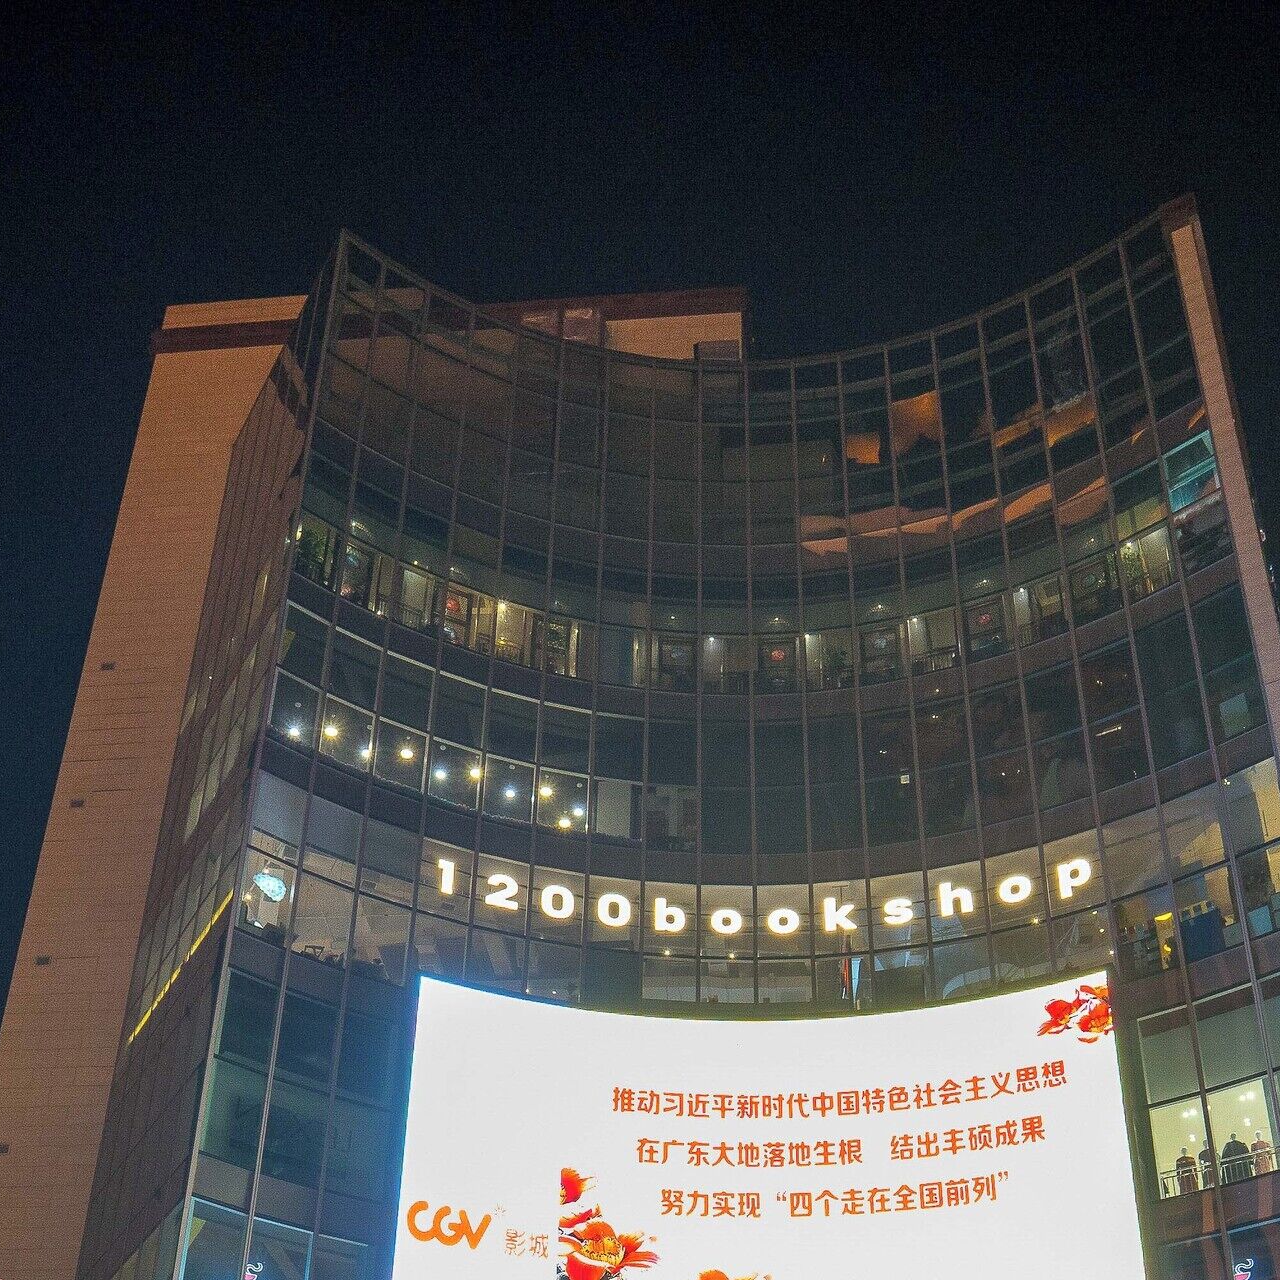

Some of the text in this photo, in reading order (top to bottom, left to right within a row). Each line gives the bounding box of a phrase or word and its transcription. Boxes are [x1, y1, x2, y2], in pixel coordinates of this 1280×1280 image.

[436, 857, 1093, 934] 1200bookshop
[612, 1059, 1067, 1119] 推动习近平新时代中国特色社会主义思想
[636, 1115, 1046, 1168] 在广东大地落地生根 结出丰硕成果
[406, 1200, 549, 1259] CGV 影城
[660, 1188, 761, 1218] 努力实现
